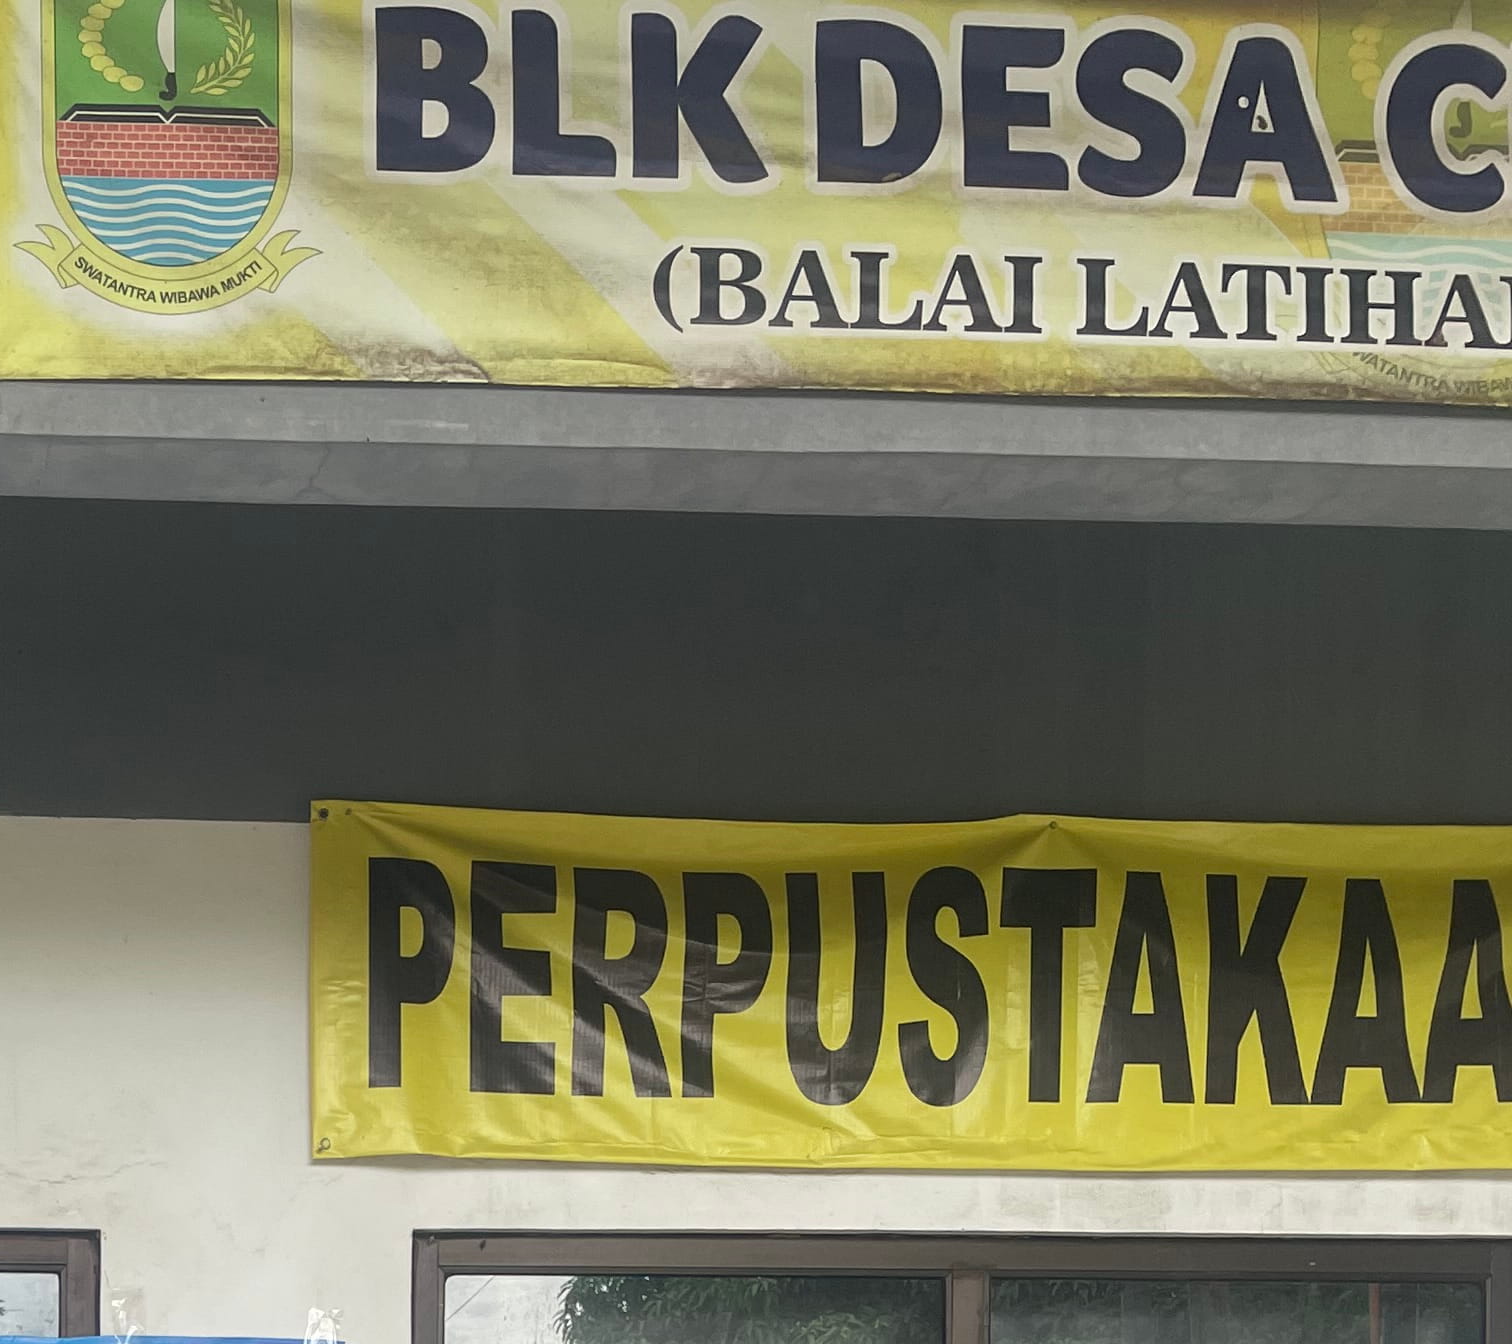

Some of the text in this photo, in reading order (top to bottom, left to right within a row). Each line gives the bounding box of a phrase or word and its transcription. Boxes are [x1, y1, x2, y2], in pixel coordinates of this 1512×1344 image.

[374, 4, 769, 186] BLK
[815, 18, 1348, 205] DESA
[74, 256, 263, 304] SWATANTRA WIBAWA MUKTI
[651, 243, 1512, 350] (BALAI LATIHA
